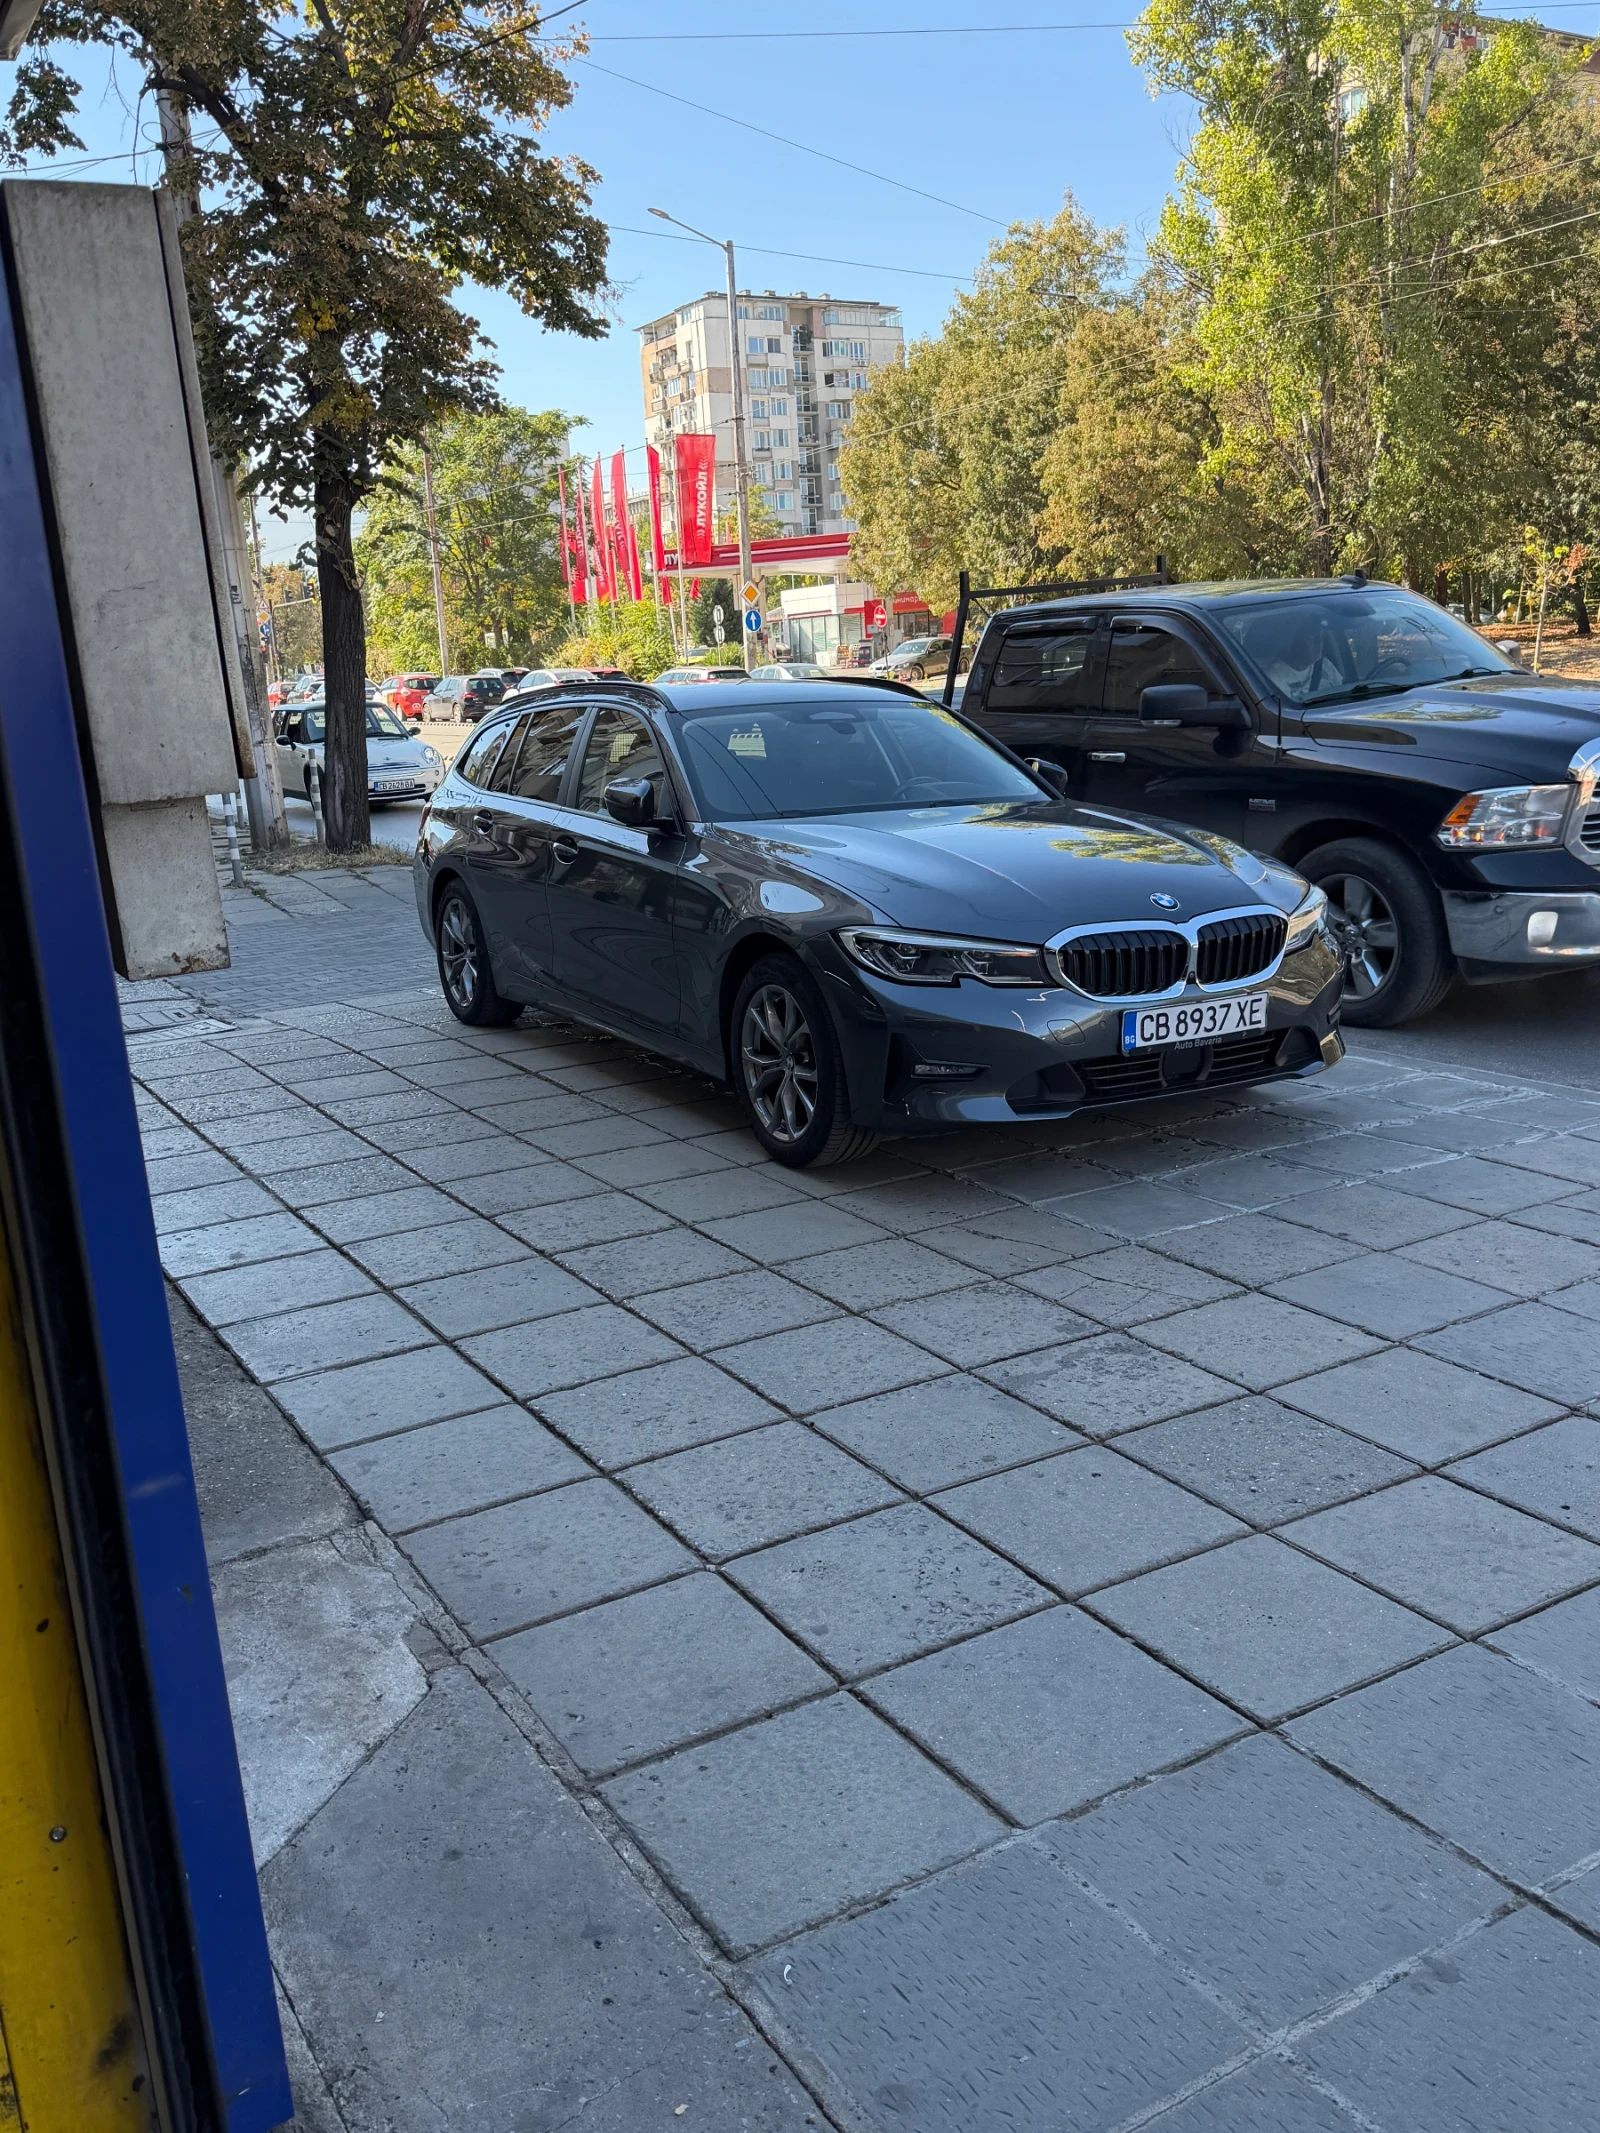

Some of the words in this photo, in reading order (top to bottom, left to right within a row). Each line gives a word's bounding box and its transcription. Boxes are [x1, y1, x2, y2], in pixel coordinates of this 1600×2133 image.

[696, 471, 708, 528] ЛУКОЙЛ
[1140, 1012, 1170, 1042] CB
[1175, 1003, 1231, 1037] 8937
[1235, 998, 1262, 1028] XE
[1124, 1035, 1135, 1044] BG
[1174, 1041, 1193, 1050] Auto
[1194, 1036, 1222, 1047] Bavaria
